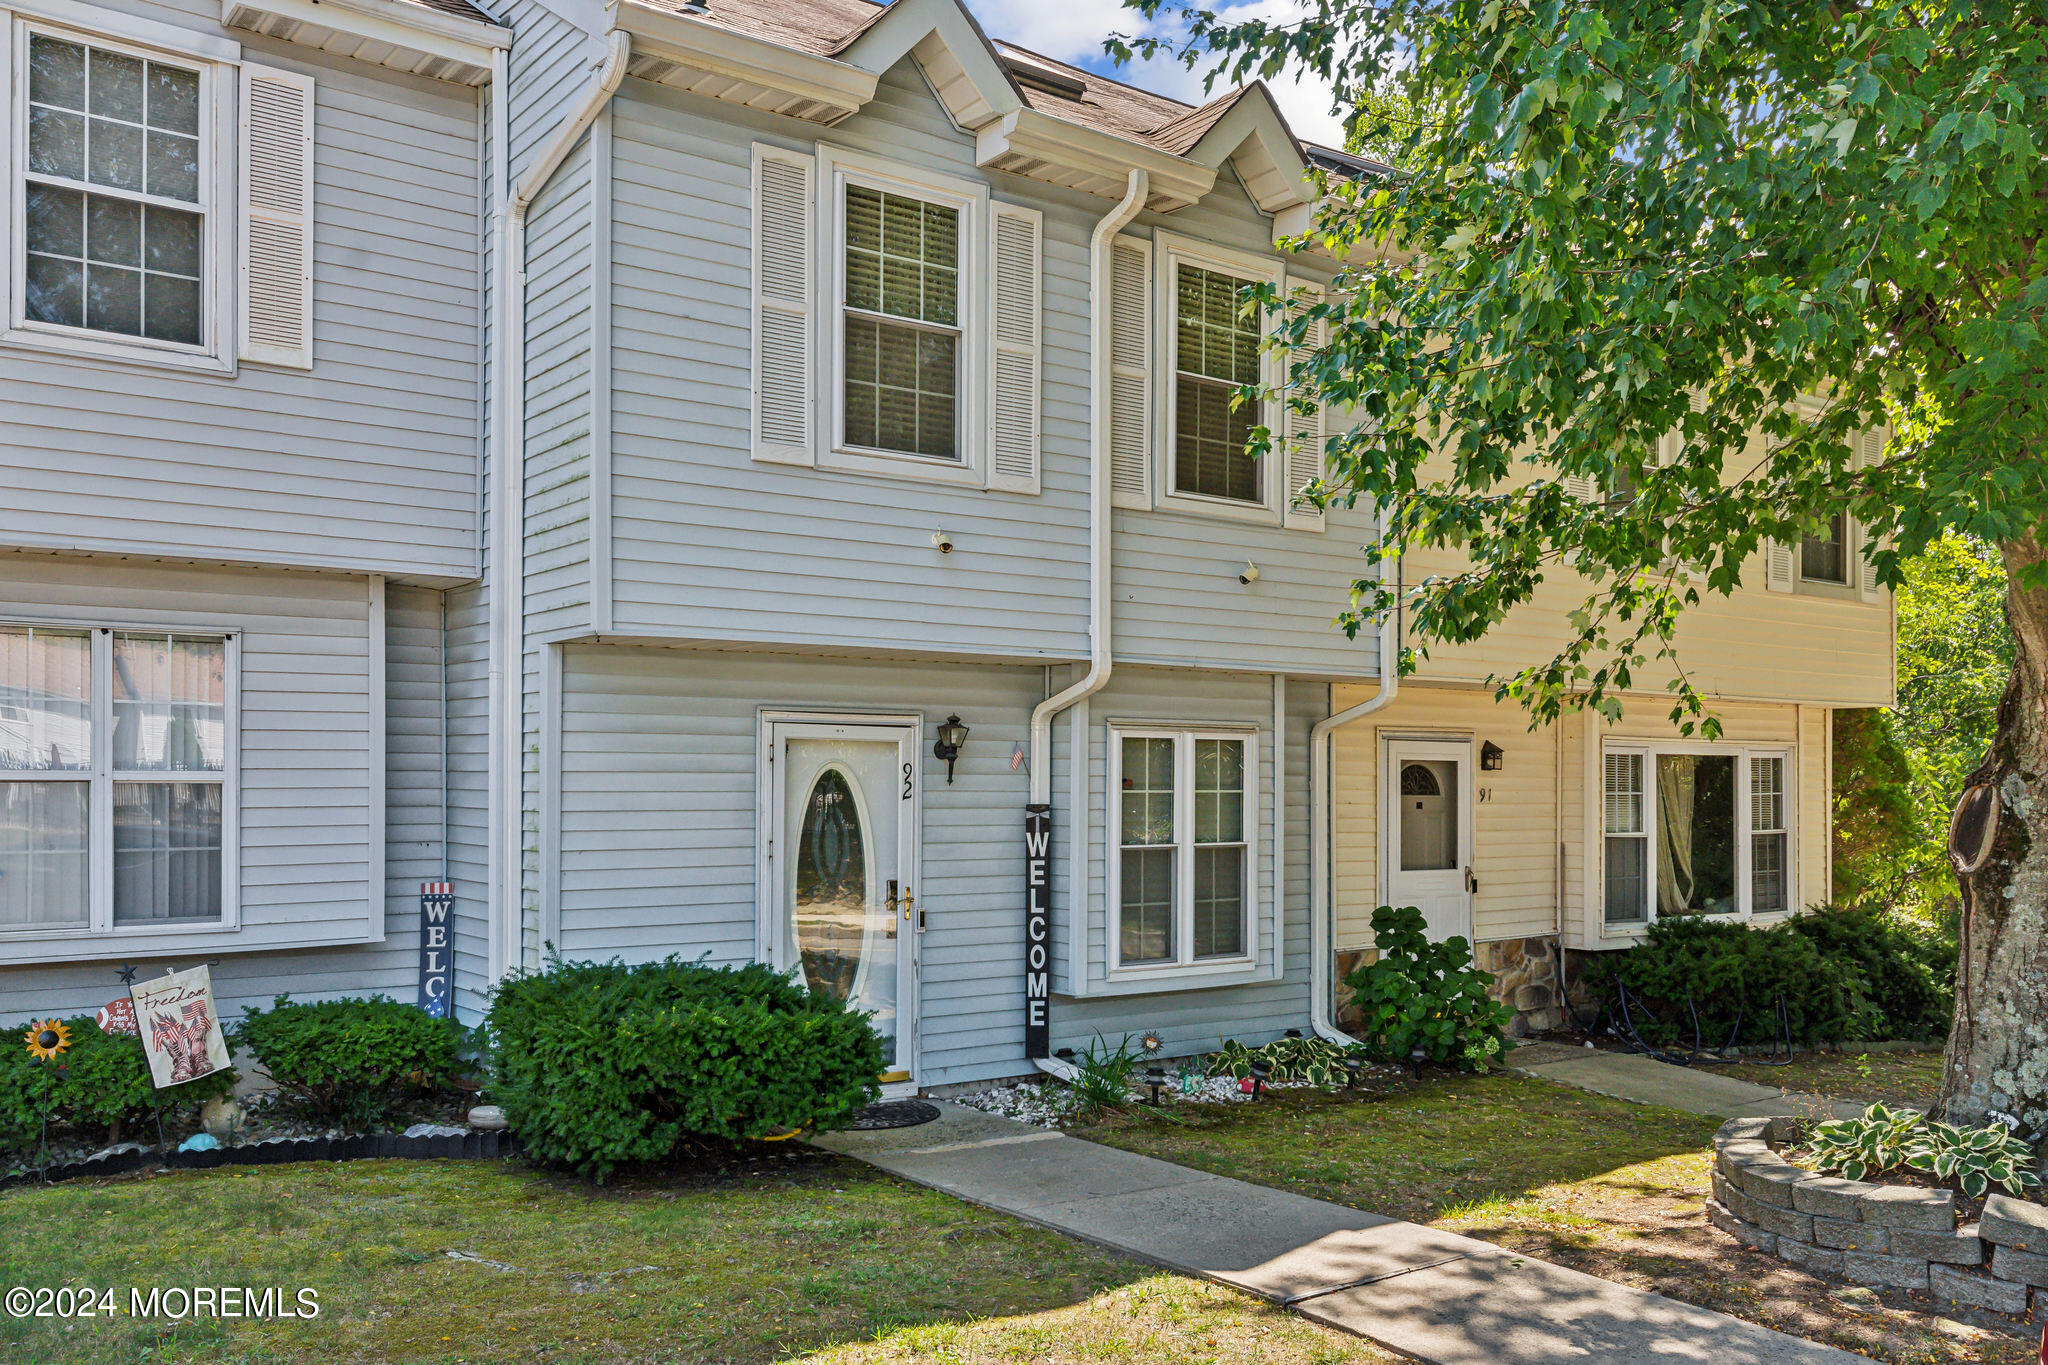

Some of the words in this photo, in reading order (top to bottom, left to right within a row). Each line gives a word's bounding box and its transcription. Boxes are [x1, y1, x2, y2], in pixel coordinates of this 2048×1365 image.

[902, 762, 912, 801] 92
[1479, 787, 1492, 803] 91
[1026, 832, 1050, 1026] WELCOME
[137, 986, 207, 1011] Freedom
